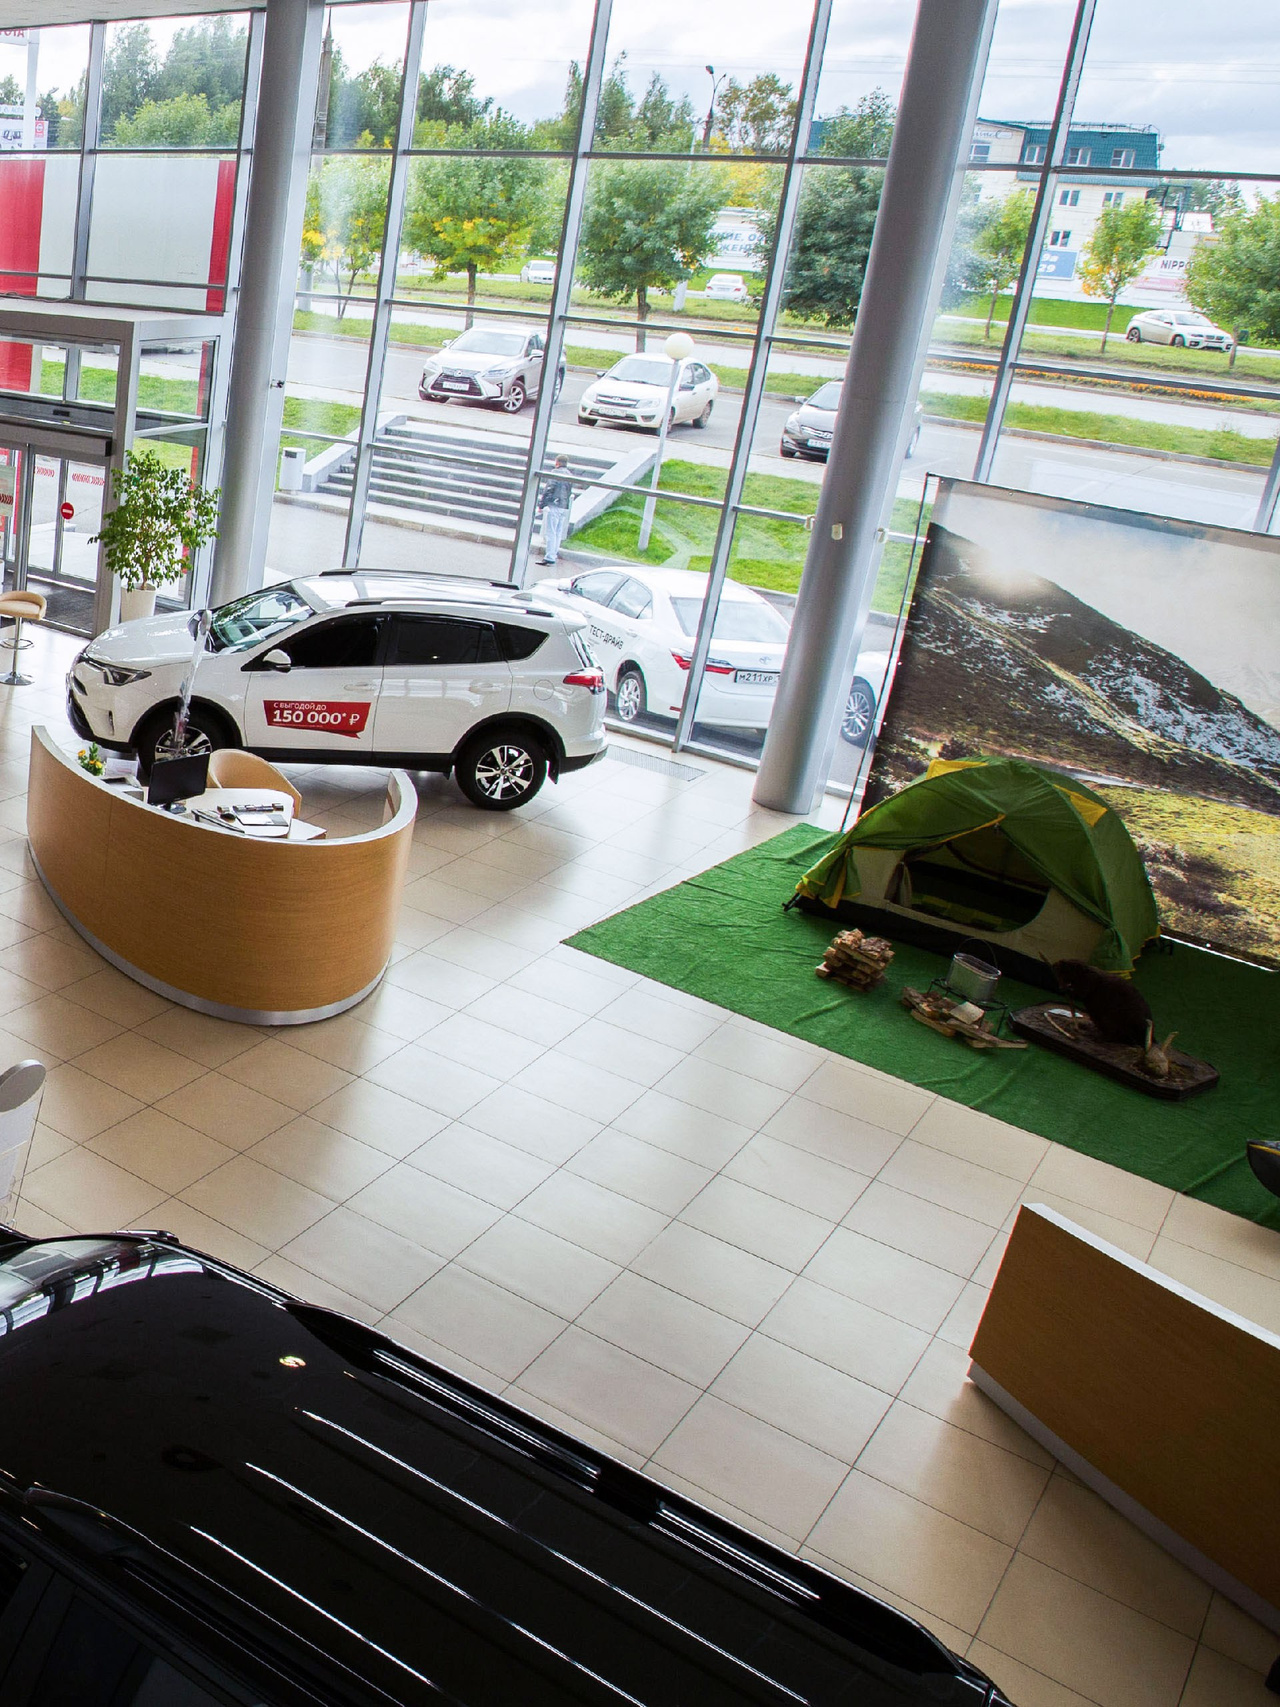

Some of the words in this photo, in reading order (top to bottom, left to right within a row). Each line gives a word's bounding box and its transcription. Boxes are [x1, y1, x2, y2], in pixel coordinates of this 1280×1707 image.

[589, 624, 624, 650] ТЕСТ-ДРАЙВ
[279, 702, 315, 710] ВЫГОДОЙ
[273, 709, 304, 723] 150
